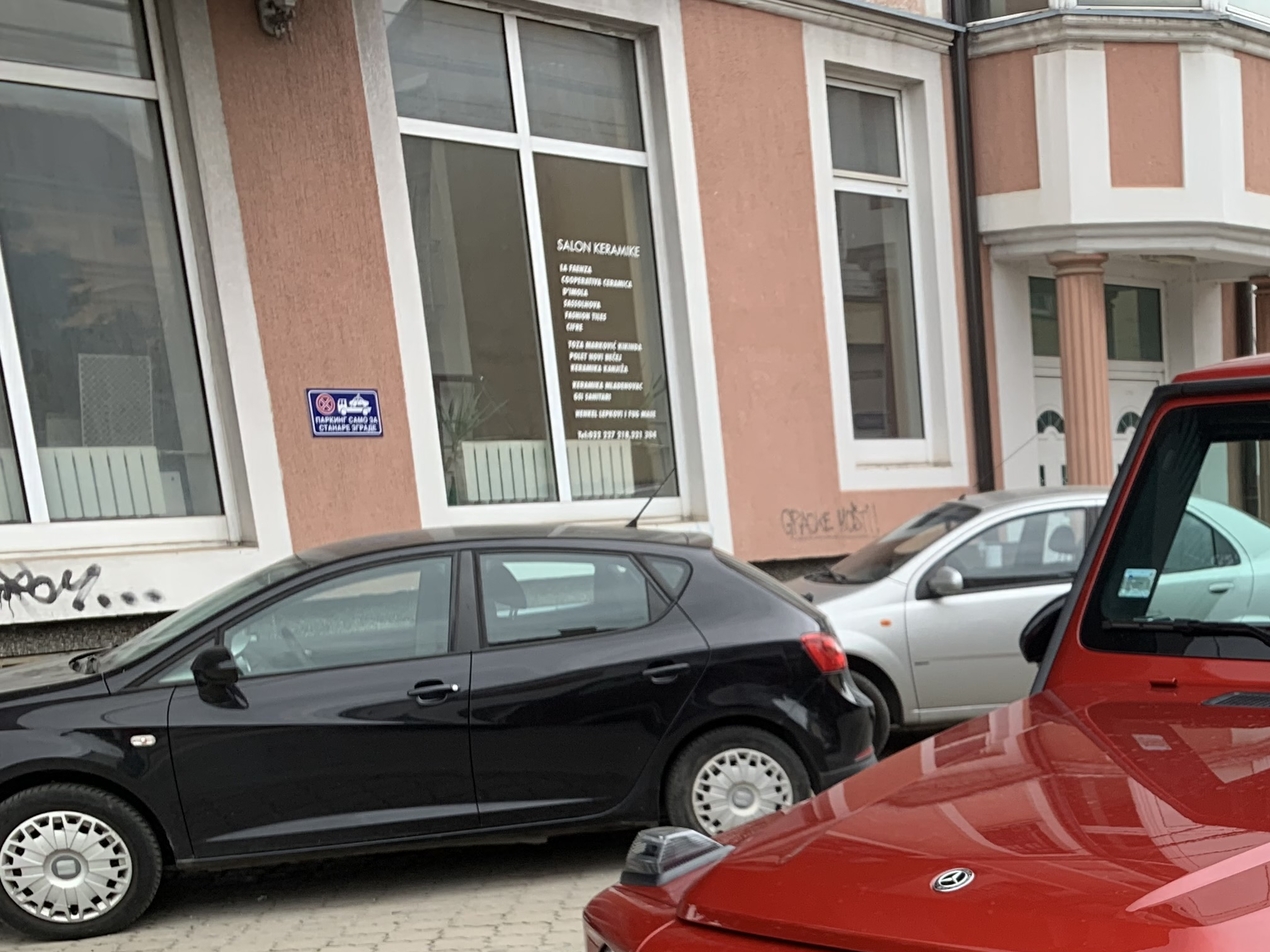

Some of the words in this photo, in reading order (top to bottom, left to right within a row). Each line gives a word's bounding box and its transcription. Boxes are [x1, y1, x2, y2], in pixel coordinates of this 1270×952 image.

[557, 239, 592, 253] SALON
[593, 243, 640, 258] KERAMIKE
[560, 264, 568, 272] LA
[569, 265, 592, 274] FAENZA
[561, 276, 602, 286] COOPERATIVA
[602, 279, 633, 289] CERAMICA
[564, 311, 590, 321] FASHION
[592, 313, 607, 322] TILES
[568, 341, 584, 349] TOZA
[585, 341, 617, 350] MARKOVIĆ
[569, 352, 588, 361] POLET
[588, 353, 604, 361] NOVI
[570, 364, 602, 372] KERAMIKA
[572, 381, 604, 390] KERAMIKA
[605, 382, 643, 391] MLADENOVAC
[575, 410, 598, 419] HENKEL
[599, 410, 624, 419] LEPKOVI
[628, 410, 639, 418] FUG
[316, 416, 347, 424] ПАРКИНГ
[348, 416, 368, 424] САМО
[369, 416, 378, 424] ЗА
[352, 424, 377, 432] ЗГРАДЕ
